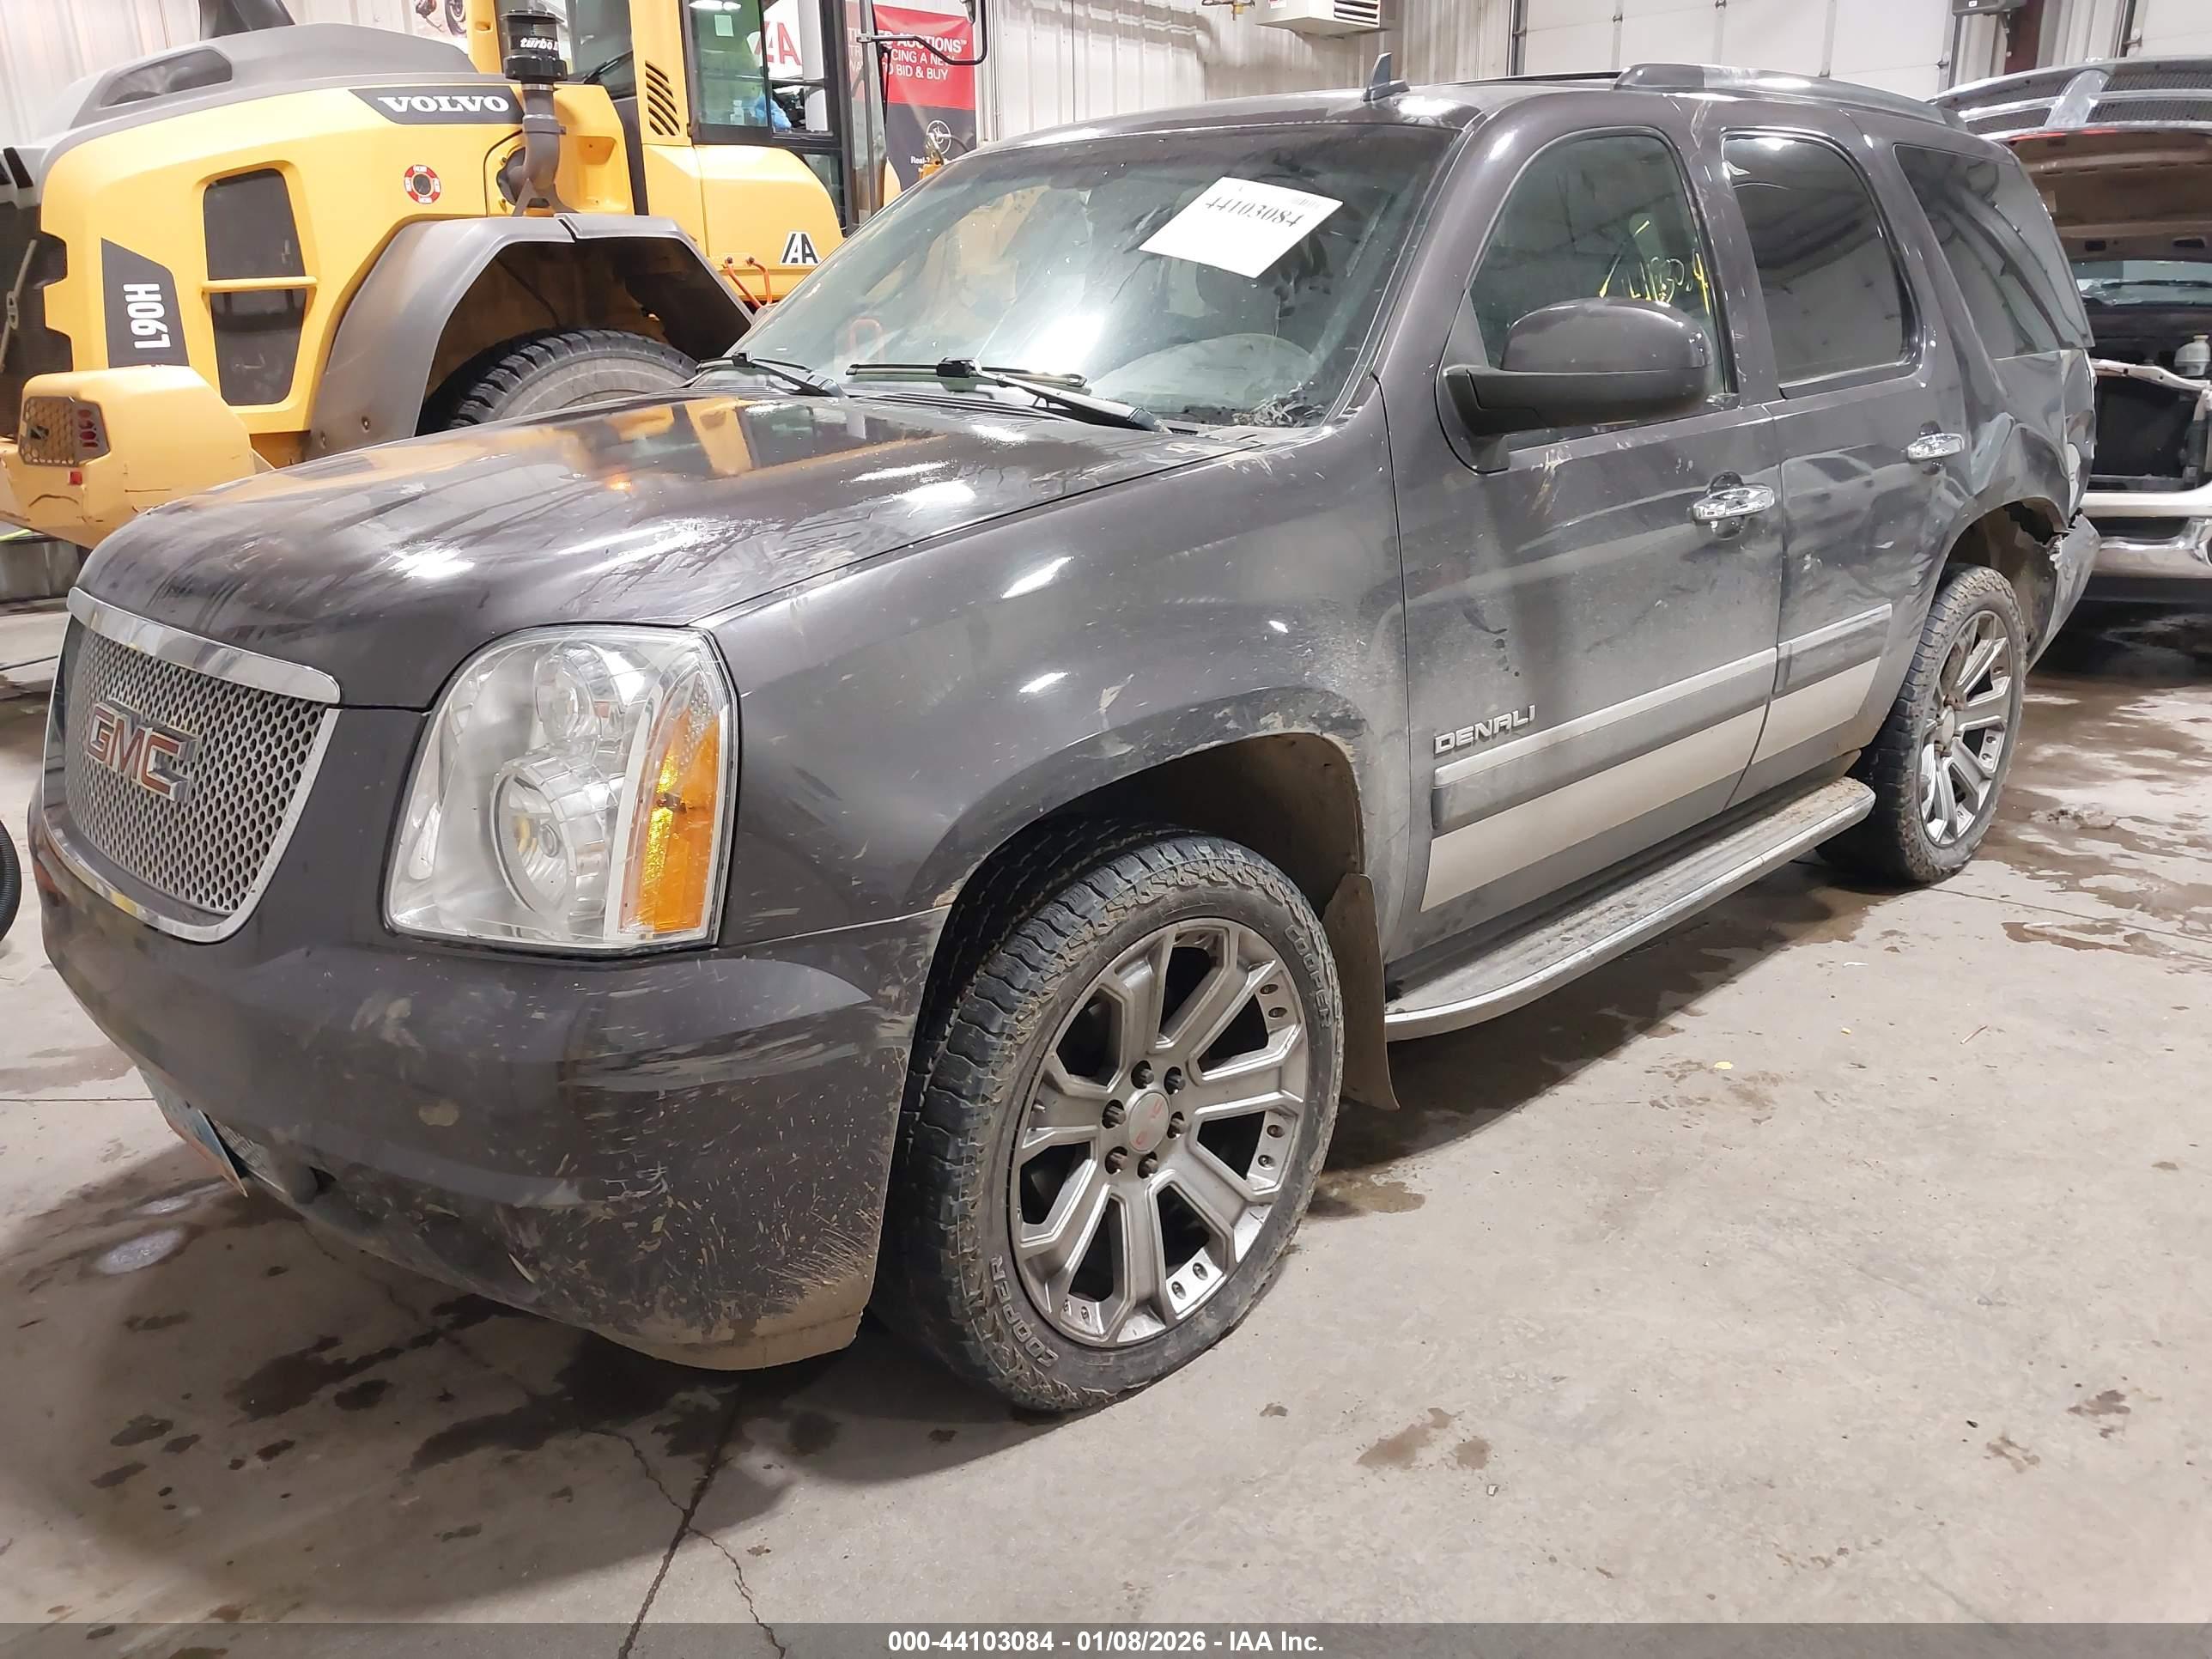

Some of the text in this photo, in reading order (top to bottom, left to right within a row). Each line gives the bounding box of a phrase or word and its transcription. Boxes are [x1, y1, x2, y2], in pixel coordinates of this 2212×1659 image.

[896, 64, 913, 76] BID
[915, 67, 924, 79] &
[927, 69, 948, 80] BUY
[920, 55, 928, 64] A
[377, 95, 509, 112] VOLVO
[1205, 197, 1304, 227] 44103084
[123, 283, 171, 349] L90H
[1434, 704, 1535, 755] DENALI
[86, 701, 192, 804] GMC
[990, 1255, 1059, 1367] COOPER
